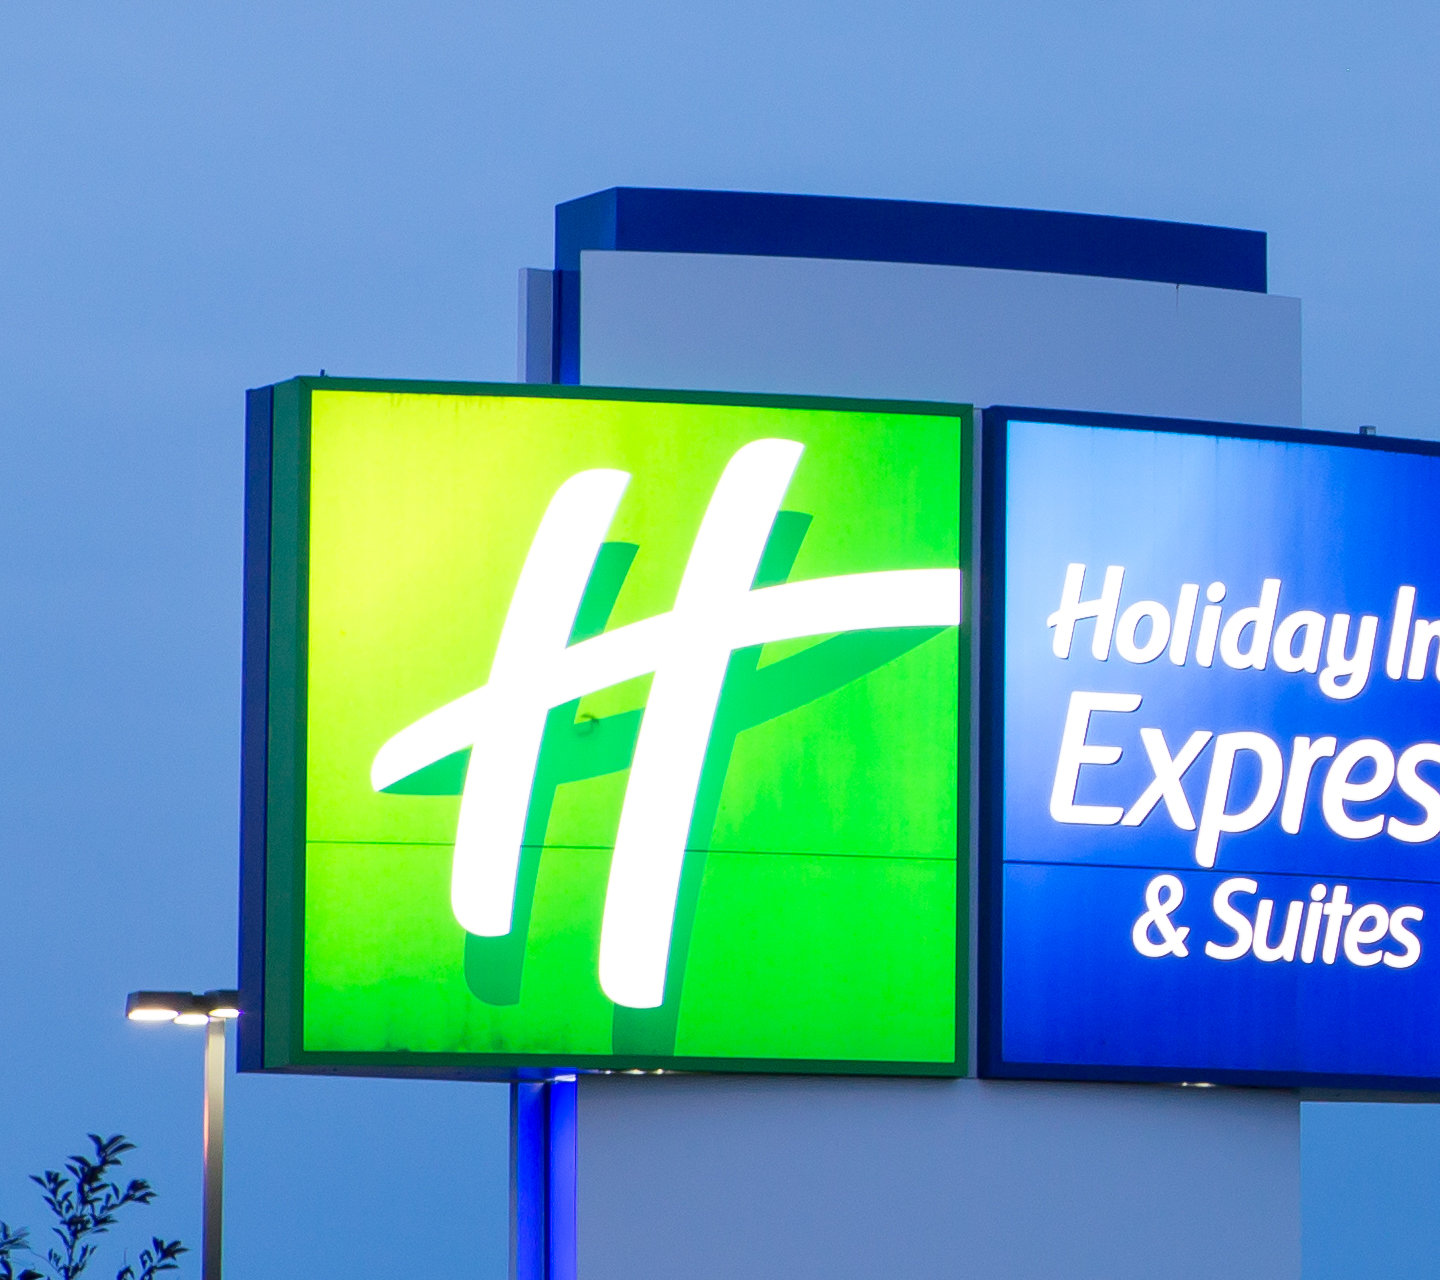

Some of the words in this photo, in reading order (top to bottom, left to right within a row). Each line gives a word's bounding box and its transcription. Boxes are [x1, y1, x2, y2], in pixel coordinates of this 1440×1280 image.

[1046, 563, 1379, 700] Holiday
[1132, 873, 1190, 959] &
[1204, 876, 1424, 969] Suites
